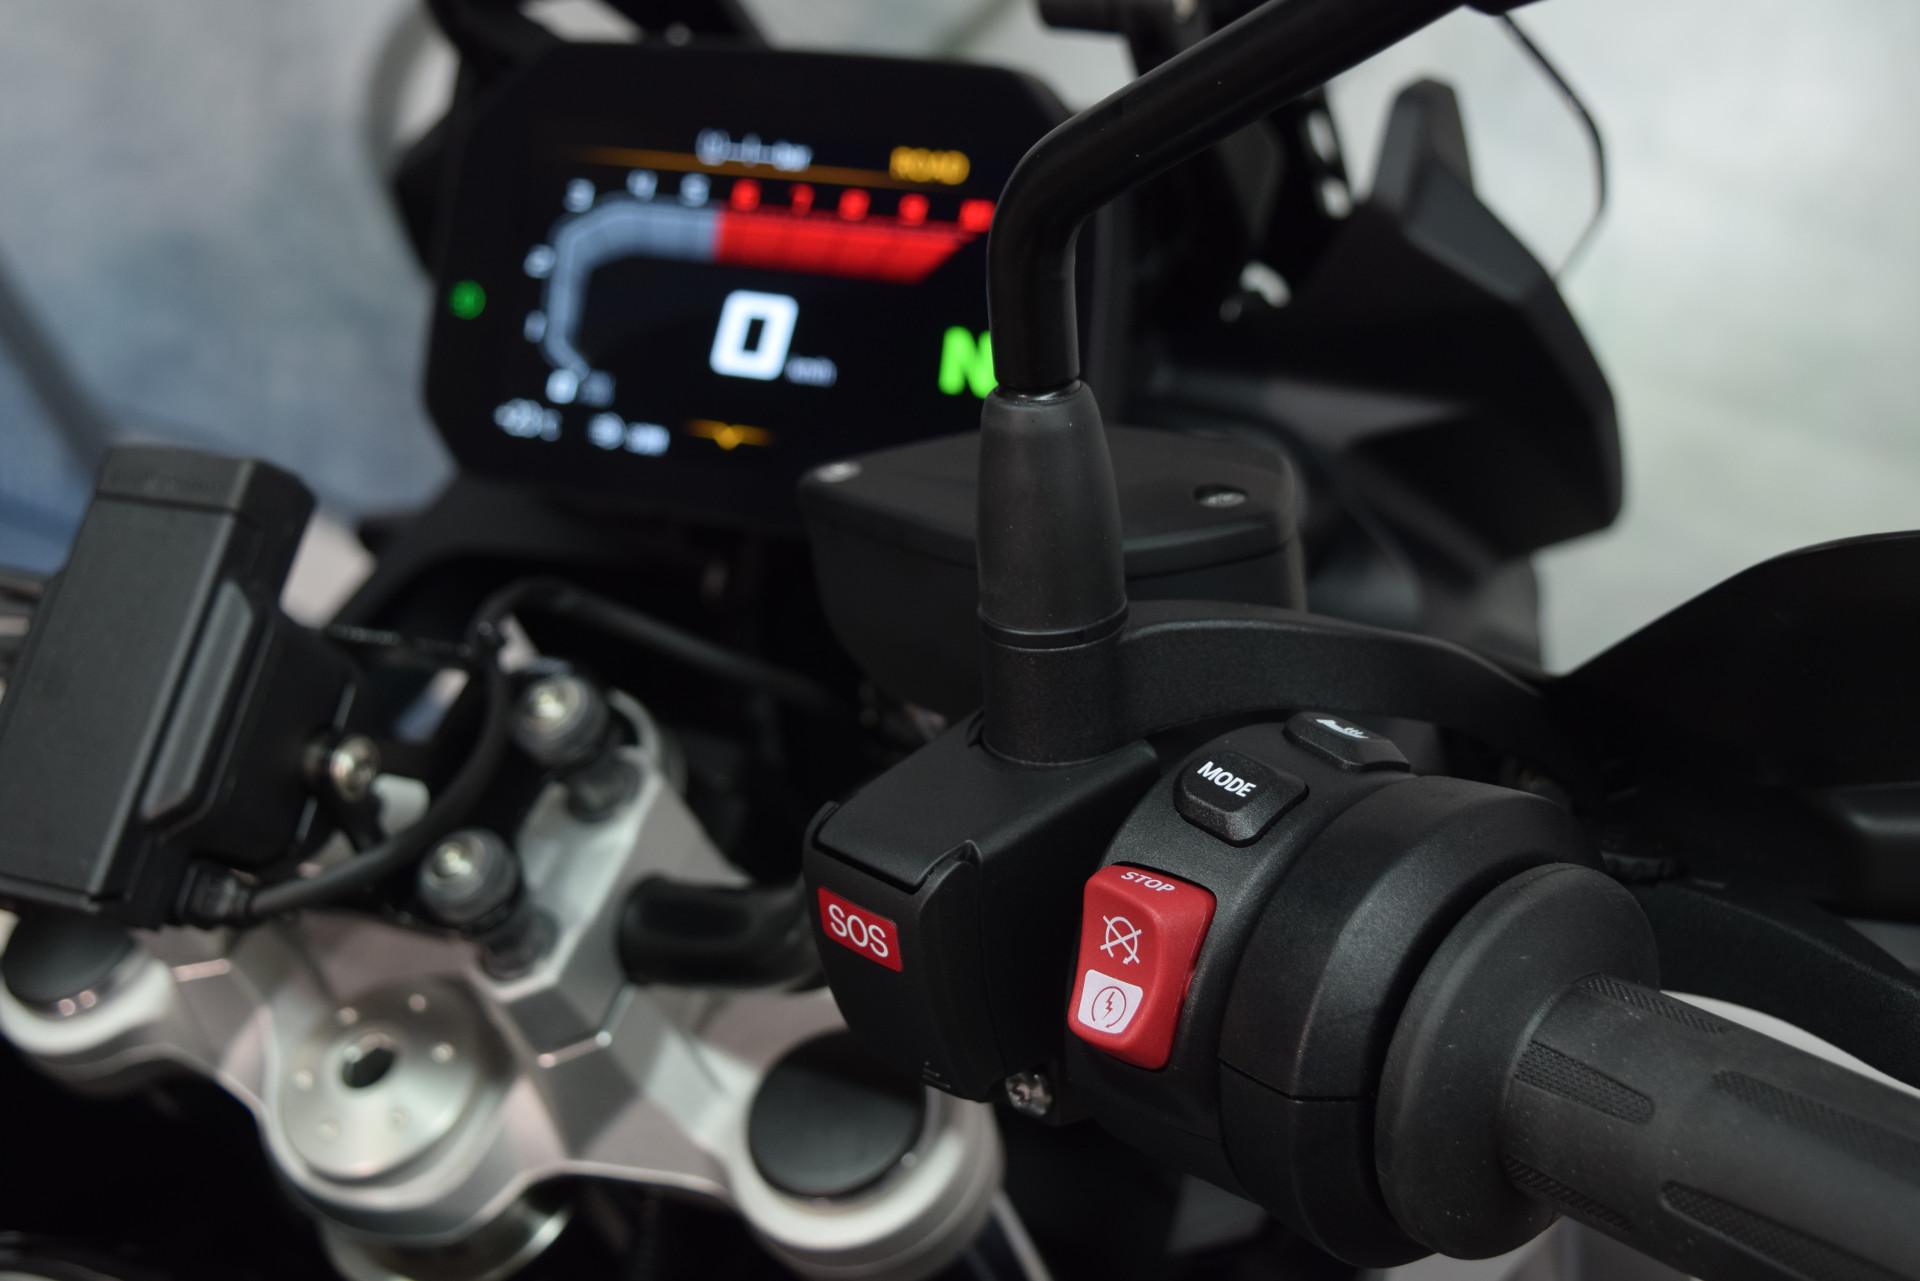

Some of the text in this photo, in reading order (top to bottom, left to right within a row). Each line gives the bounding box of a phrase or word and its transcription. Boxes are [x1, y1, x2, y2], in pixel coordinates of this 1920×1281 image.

[710, 289, 799, 380] 0
[938, 325, 997, 398] N
[1197, 761, 1256, 798] MODE
[1121, 871, 1175, 892] STOP
[828, 904, 889, 957] SOS
